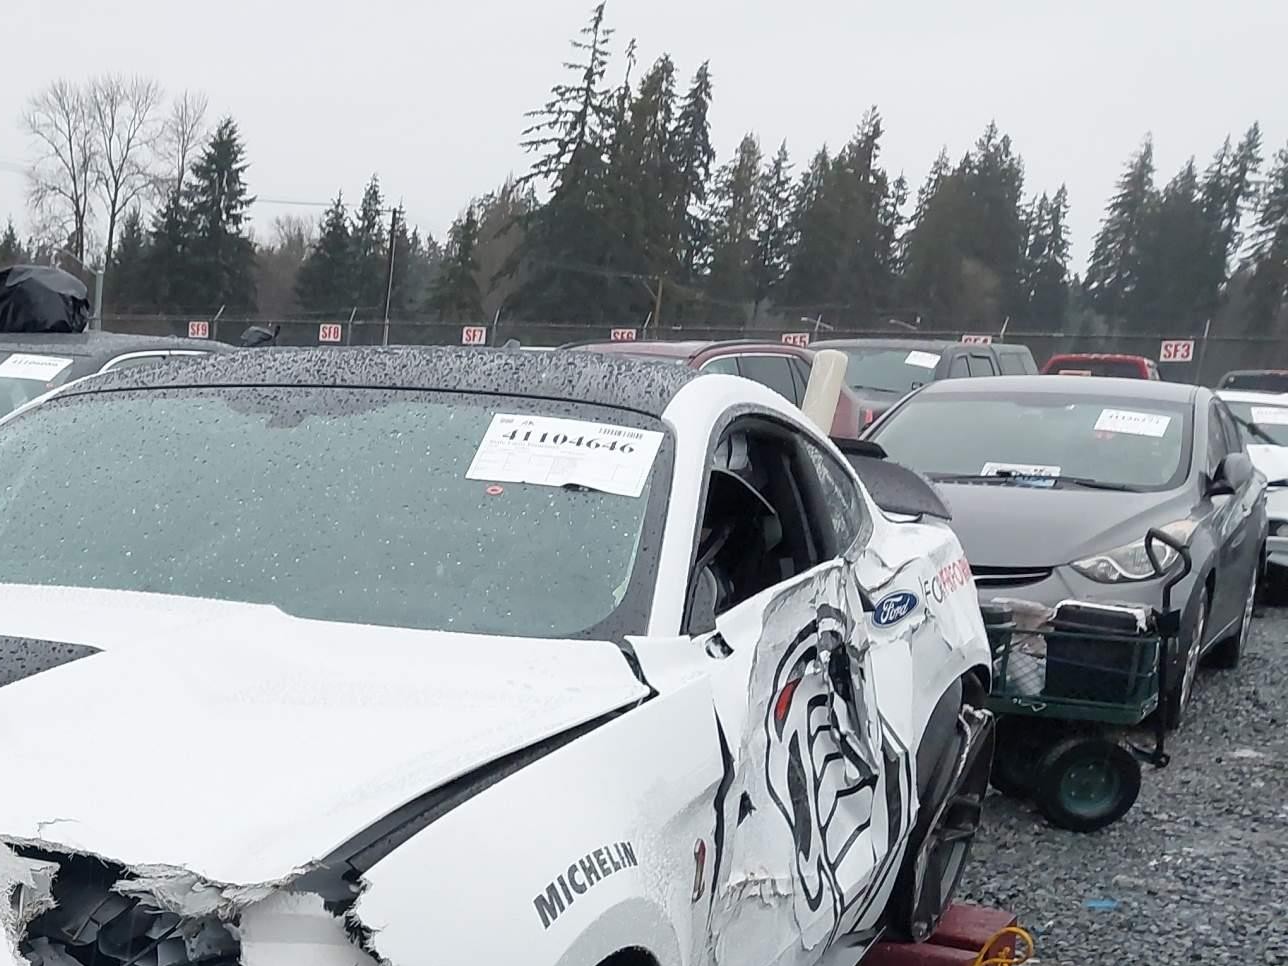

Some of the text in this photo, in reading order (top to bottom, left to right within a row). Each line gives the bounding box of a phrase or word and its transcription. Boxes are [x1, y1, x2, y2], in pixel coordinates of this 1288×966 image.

[190, 323, 207, 336] SF9
[465, 329, 483, 343] SF7
[1163, 343, 1190, 359] SF3
[502, 429, 635, 454] 41104646
[880, 595, 911, 624] Ford
[533, 840, 638, 930] MICHELIN
